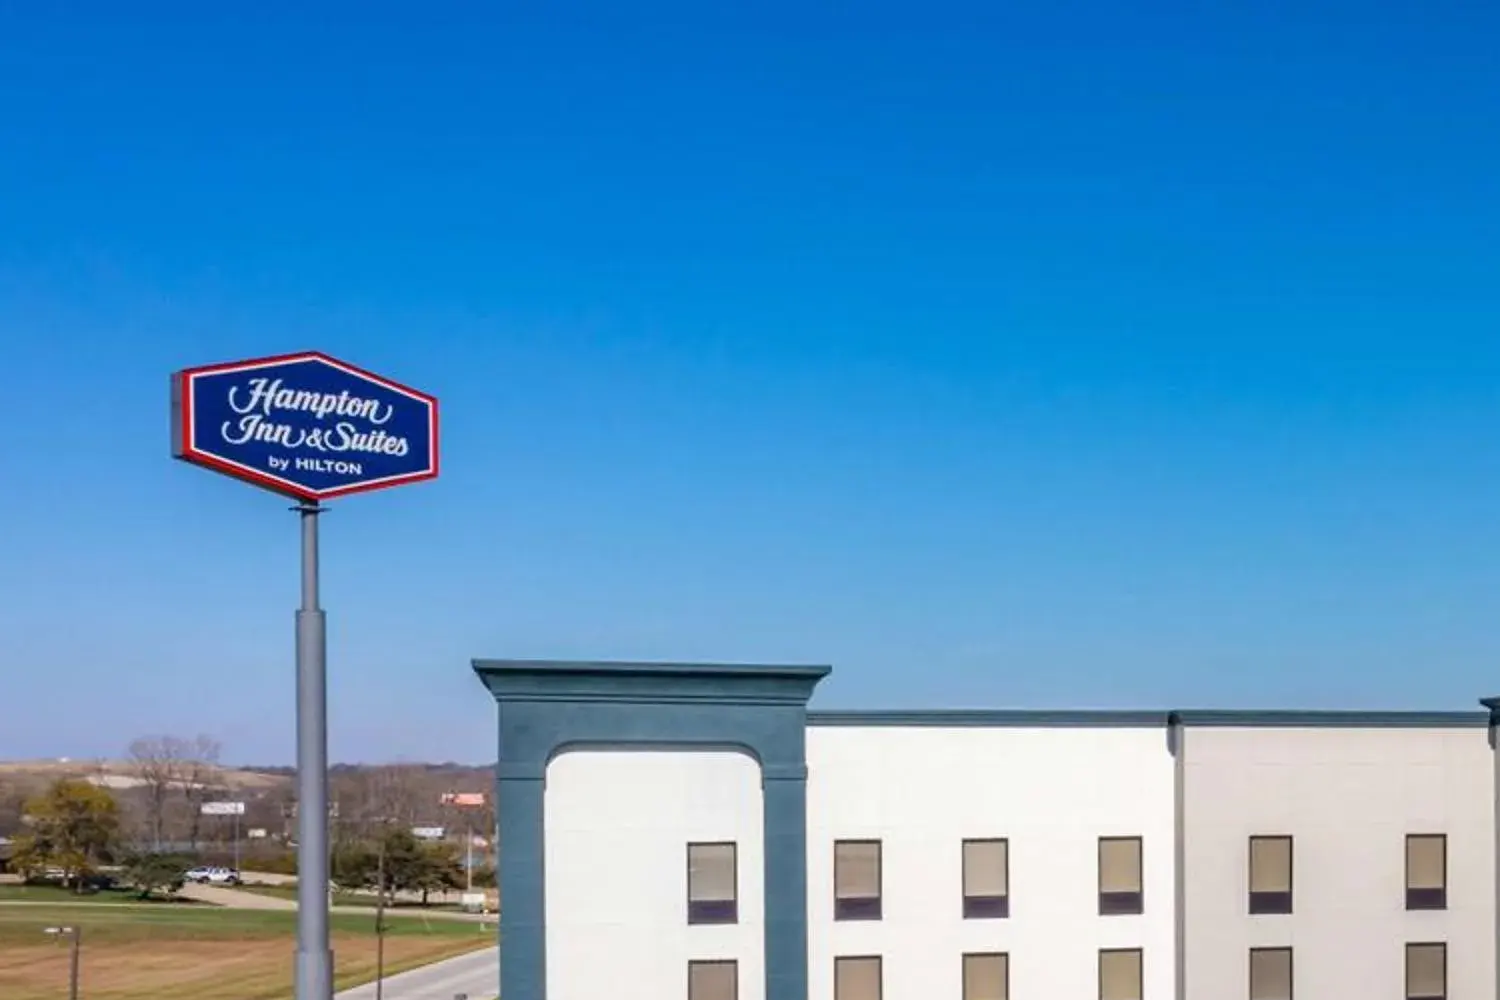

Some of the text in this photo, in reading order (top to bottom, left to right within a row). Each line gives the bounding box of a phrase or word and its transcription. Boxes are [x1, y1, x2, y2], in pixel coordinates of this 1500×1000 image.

[229, 378, 393, 425] Hampton
[221, 415, 408, 457] Inn & Suites
[268, 455, 362, 476] by HILTON
